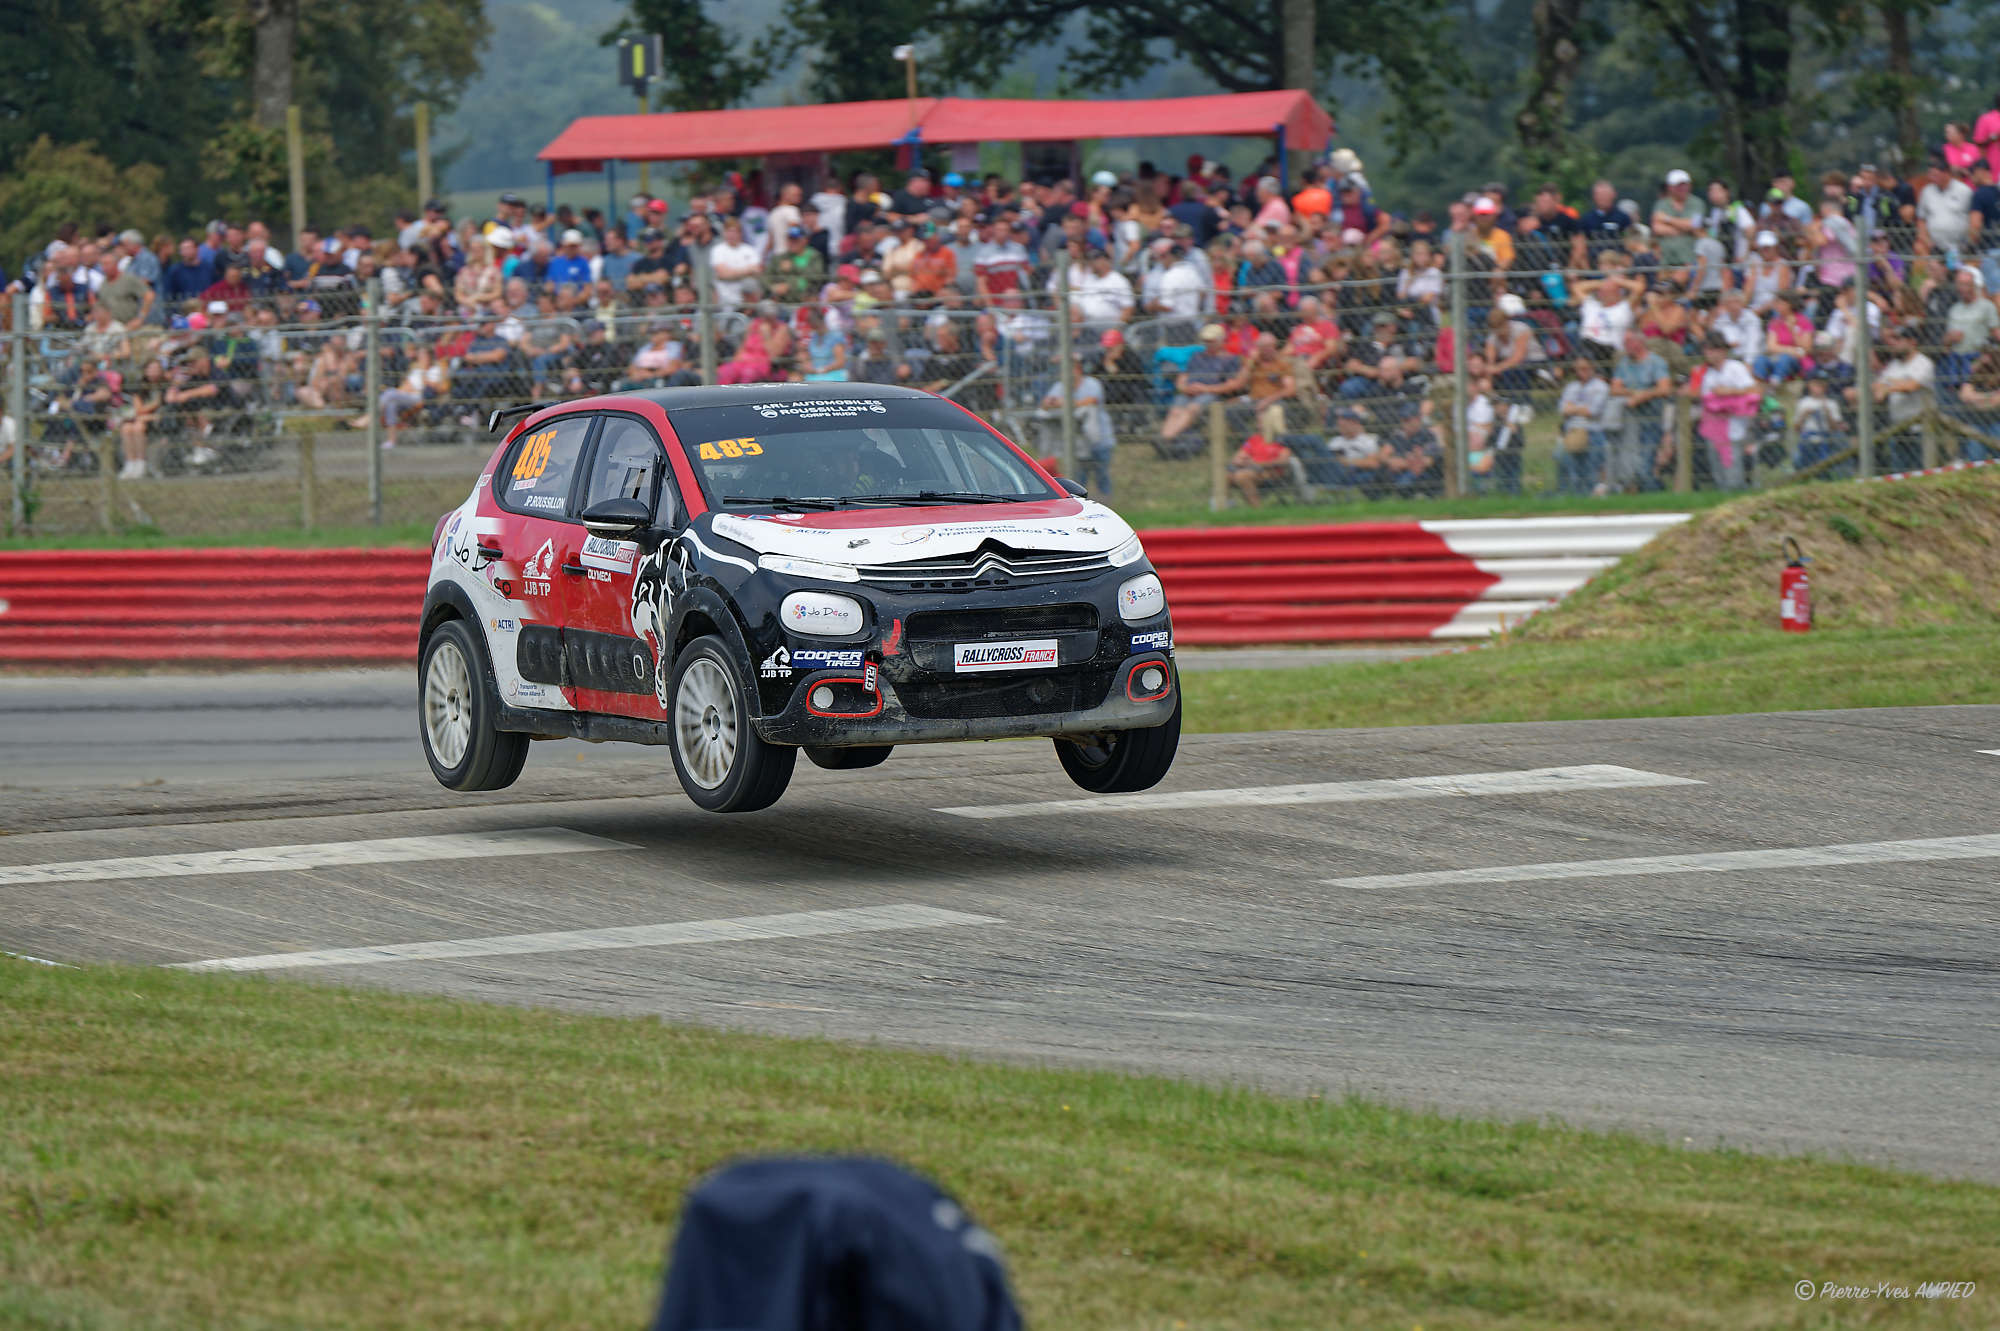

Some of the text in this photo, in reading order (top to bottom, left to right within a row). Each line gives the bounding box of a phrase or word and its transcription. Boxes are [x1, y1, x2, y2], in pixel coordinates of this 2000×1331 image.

[752, 399, 882, 411] SARL AUTOMOBILES
[779, 406, 868, 416] ROUSSILLON
[699, 437, 764, 460] 485
[512, 430, 558, 480] 485
[1044, 527, 1070, 536] 35
[523, 581, 551, 597] JJB TP
[808, 607, 820, 616] Jo
[1131, 631, 1169, 645] COOPER
[793, 650, 863, 661] COOPER
[961, 646, 1055, 663] RALLYCROSS FRANCE
[760, 670, 792, 678] JJB TP
